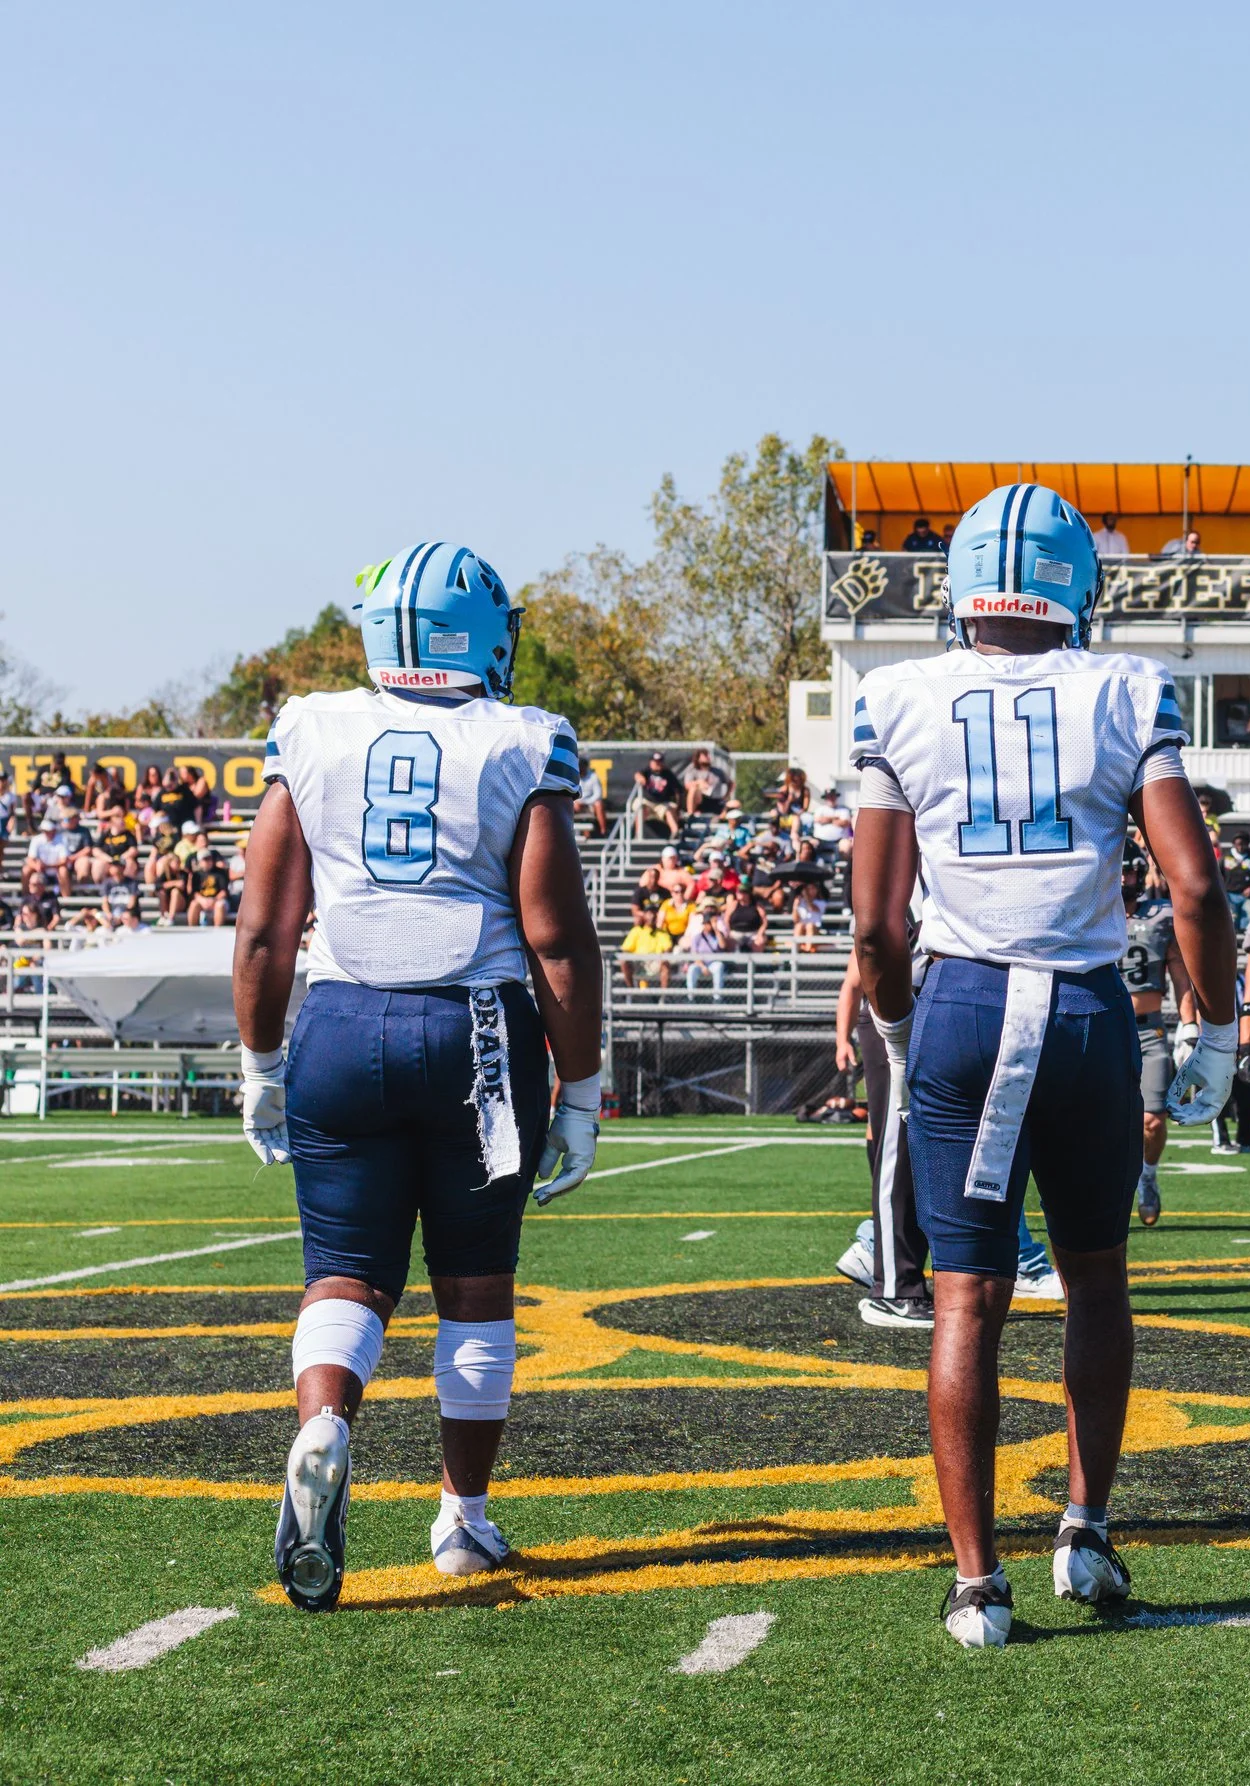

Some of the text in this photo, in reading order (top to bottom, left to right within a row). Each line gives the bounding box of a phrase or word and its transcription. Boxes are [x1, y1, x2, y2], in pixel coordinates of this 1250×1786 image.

[972, 598, 1048, 616] Riddell
[380, 671, 448, 686] Riddell
[363, 730, 443, 885] 8
[951, 687, 1073, 857] 11
